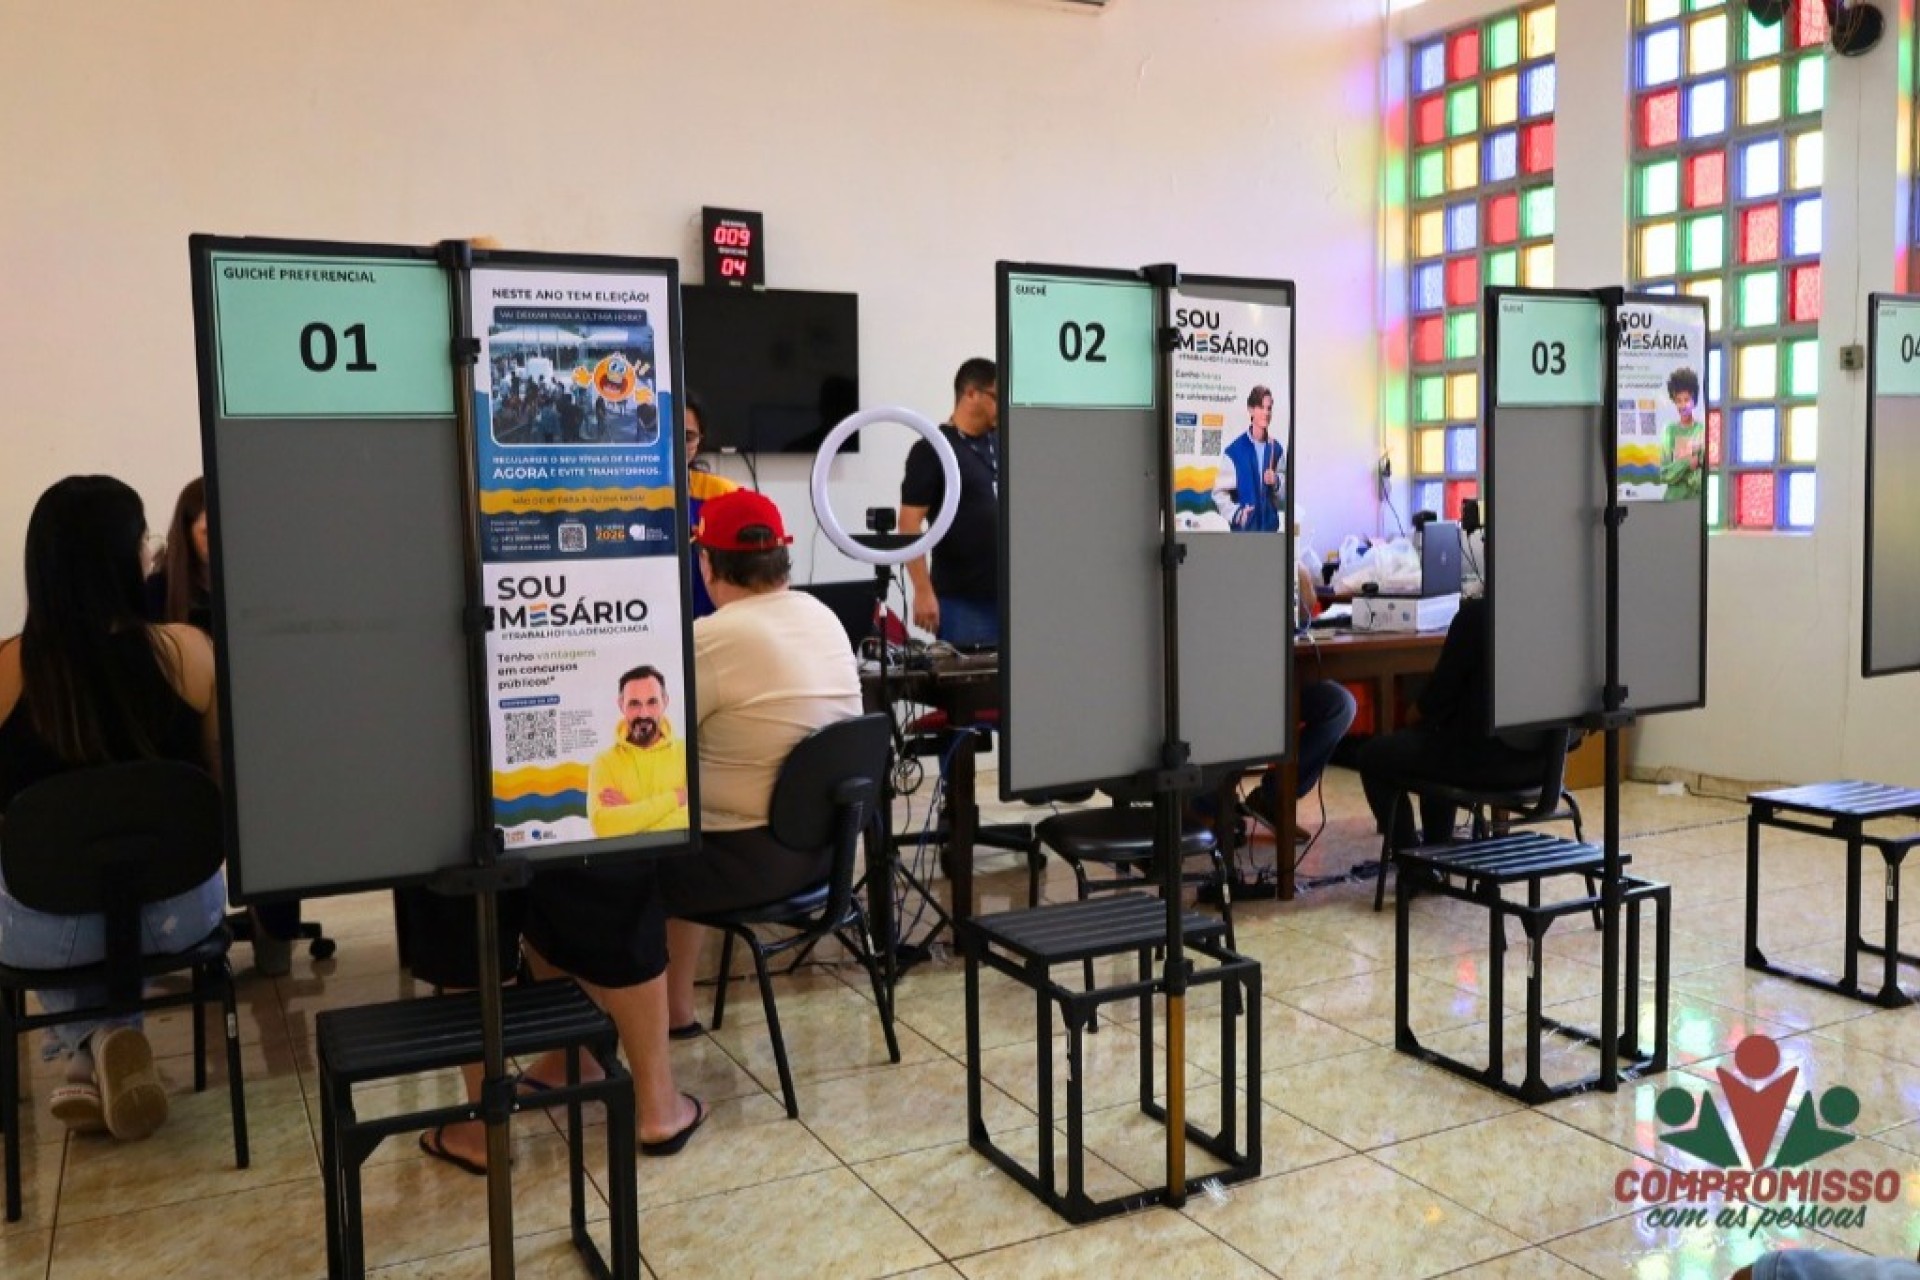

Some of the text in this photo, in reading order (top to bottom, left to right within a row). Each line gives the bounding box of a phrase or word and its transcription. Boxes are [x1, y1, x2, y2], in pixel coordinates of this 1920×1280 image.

[714, 227, 750, 246] 009
[224, 266, 376, 283] GUICHÊ PREFERENCIAL
[721, 259, 746, 276] 04
[492, 288, 649, 304] NESTE ANO TEM ELEIÇÃO!
[1176, 308, 1220, 330] SOU
[300, 321, 377, 372] 01
[1059, 320, 1107, 362] 02
[1177, 330, 1269, 358] MESÁRIO
[1618, 330, 1688, 350] MESÁRIA
[1532, 340, 1566, 375] 03
[493, 466, 548, 480] AGORA
[497, 575, 566, 600] SOU
[500, 596, 648, 629] MESÁRIO
[497, 650, 596, 663] Tenho vantagens
[498, 663, 578, 676] em concursos
